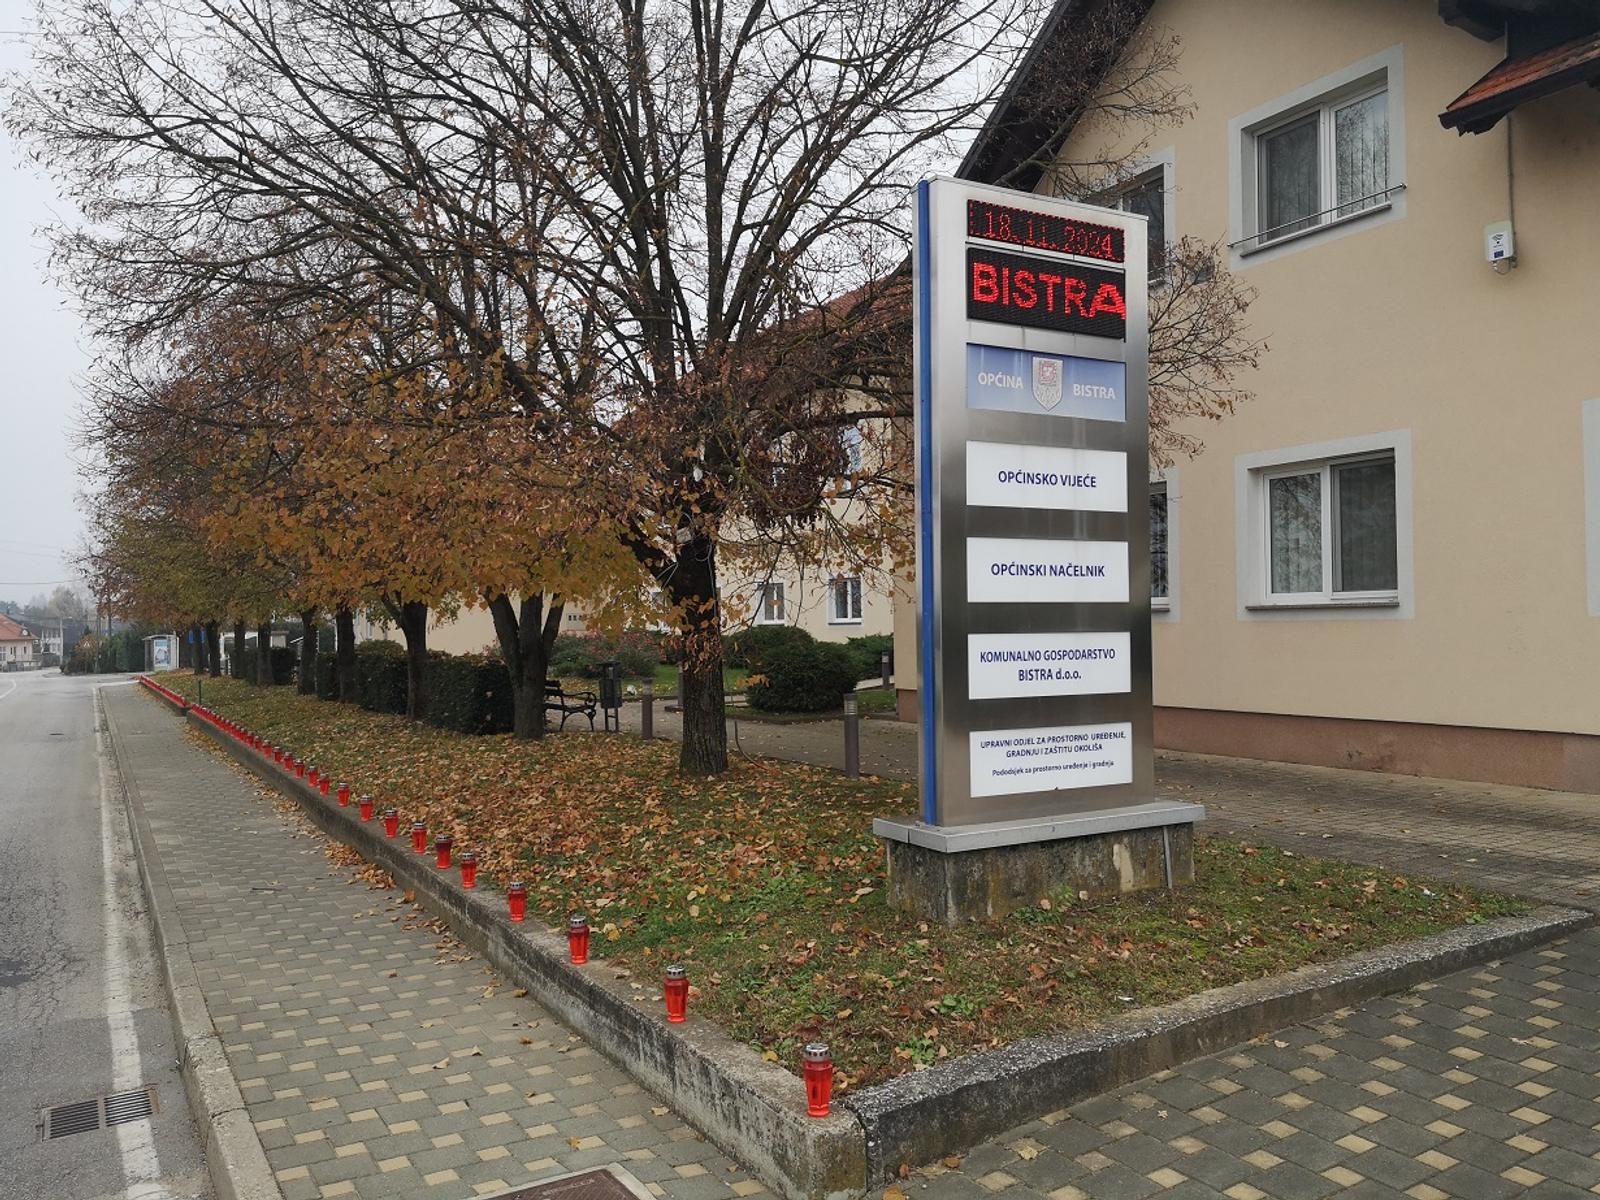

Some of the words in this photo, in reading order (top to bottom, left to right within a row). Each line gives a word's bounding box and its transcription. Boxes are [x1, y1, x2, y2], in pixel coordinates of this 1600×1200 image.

[973, 262, 1126, 320] BISTRA
[978, 371, 1024, 389] OPĆINA
[1073, 383, 1116, 400] BISTRA
[998, 469, 1058, 486] OPĆINSKO
[1060, 473, 1097, 488] VIJEĆE
[991, 562, 1046, 576] OPĆINSKI
[1049, 563, 1105, 577] NAČELNIK
[980, 650, 1042, 663] KOMUNALNO
[1043, 648, 1116, 661] GOSPODARSTVO
[1018, 669, 1053, 681] BISTRA
[1055, 668, 1082, 680] d.o.o.
[980, 739, 1013, 749] UPRAVNI
[1013, 737, 1036, 746] ODJEL
[1036, 736, 1046, 745] ZA
[1047, 734, 1089, 743] PROSTORNO
[1006, 747, 1040, 758] GRADNJU
[1044, 745, 1073, 755] ZAŠTITU
[1074, 743, 1102, 752] OKOLIŠA
[992, 768, 1024, 776] Pododsjek
[1032, 764, 1062, 774] prostorno
[1062, 761, 1089, 770] uređenje
